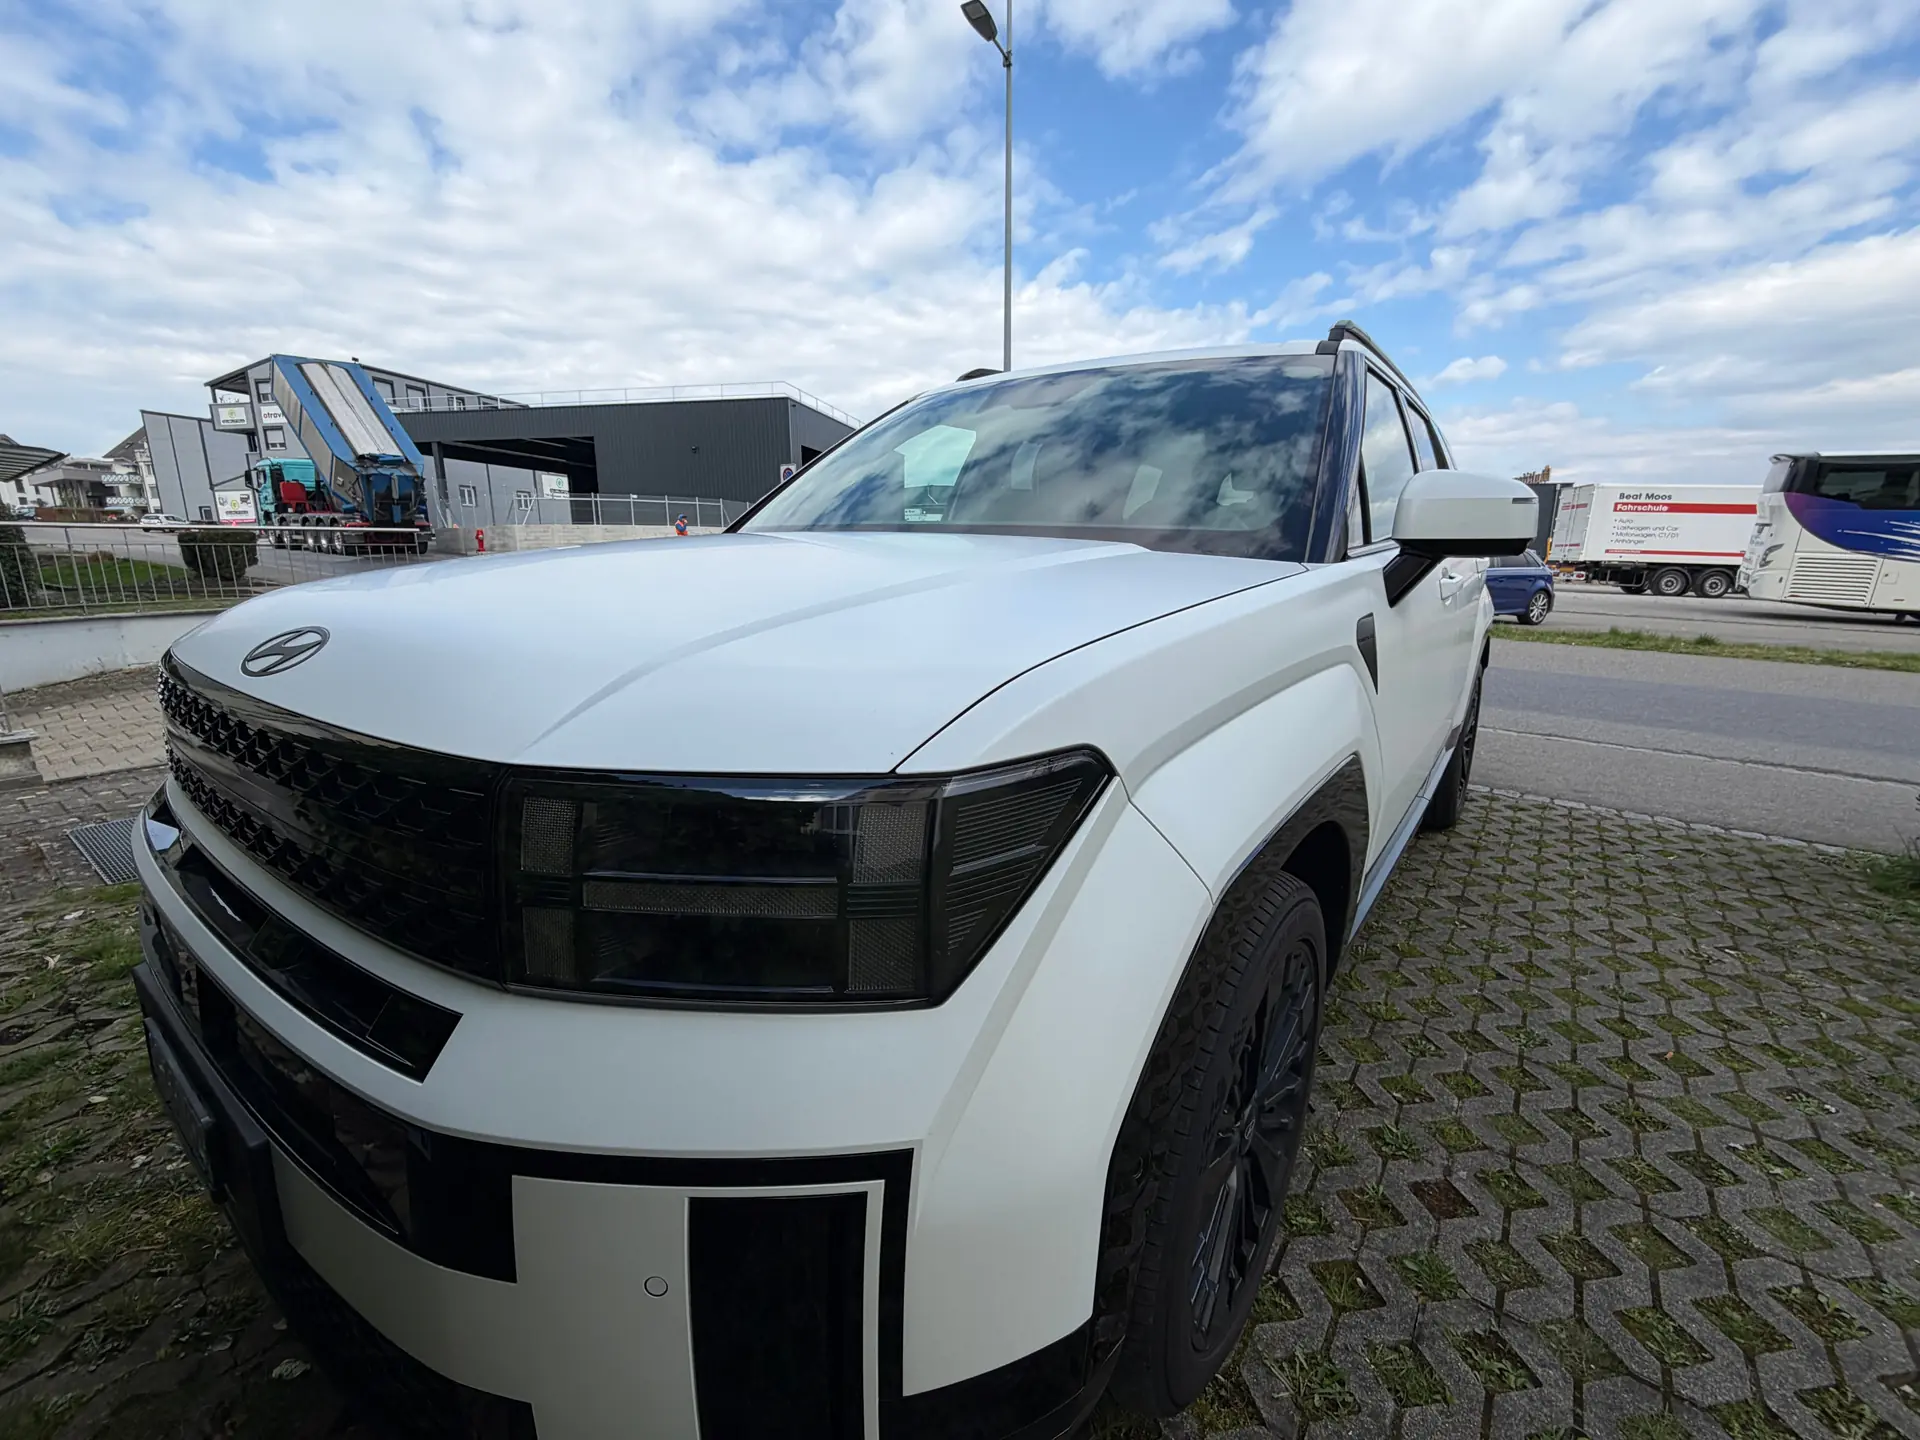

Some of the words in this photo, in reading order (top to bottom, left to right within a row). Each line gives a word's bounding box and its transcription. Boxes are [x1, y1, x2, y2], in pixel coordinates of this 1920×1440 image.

[1619, 492, 1642, 500] Beat
[1645, 493, 1673, 501] Moos
[1616, 503, 1669, 512] Fahrschule
